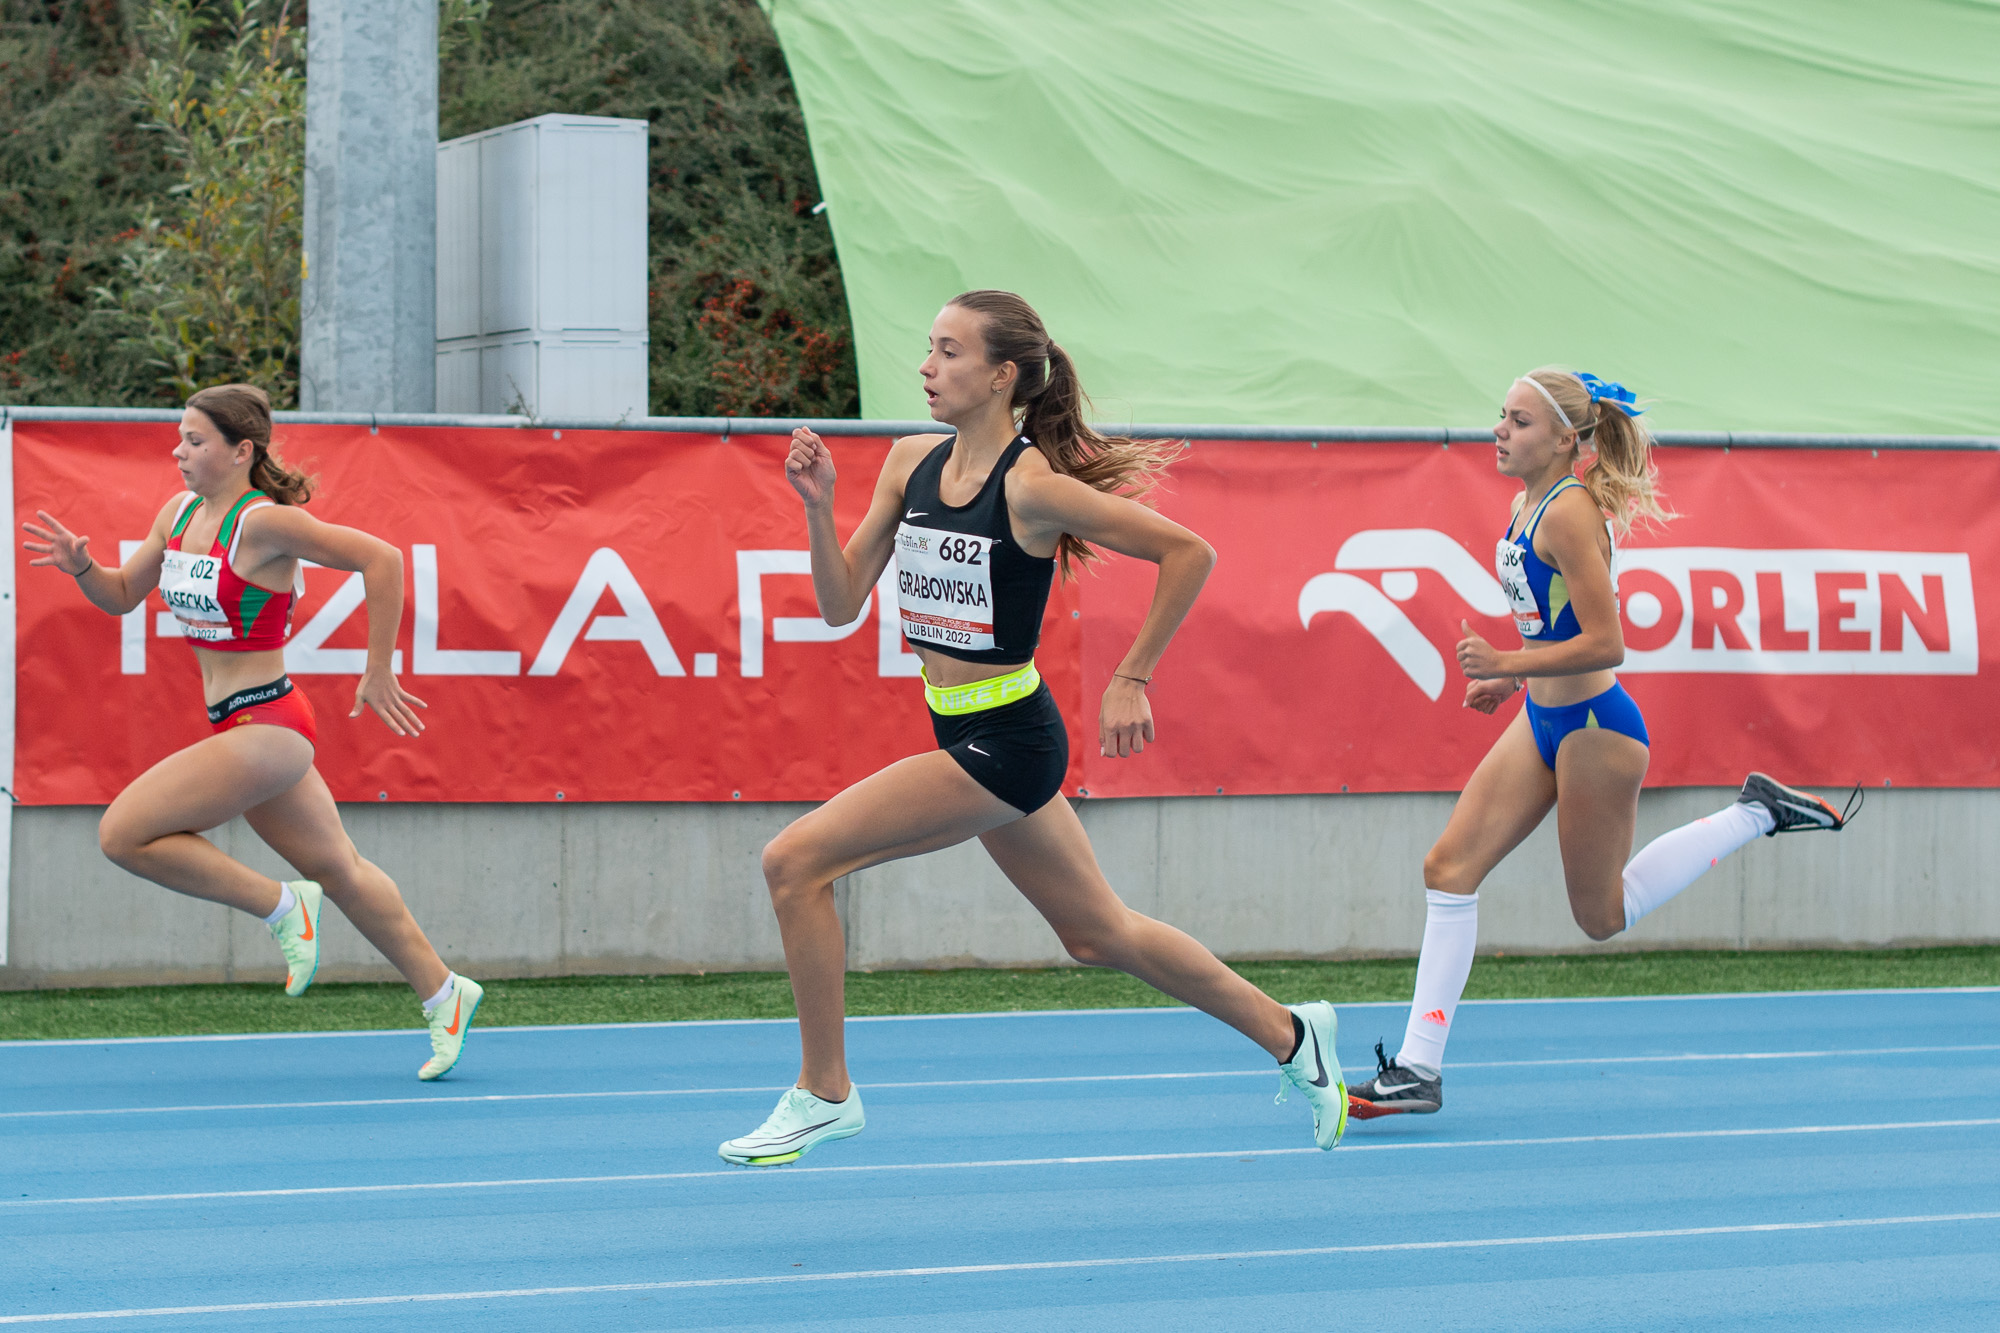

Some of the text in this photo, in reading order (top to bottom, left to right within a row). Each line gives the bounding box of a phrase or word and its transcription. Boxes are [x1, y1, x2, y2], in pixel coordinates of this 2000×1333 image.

[938, 536, 982, 566] 682
[898, 568, 989, 609] GRABOWSKA
[1617, 567, 1951, 653] ORLEN
[197, 628, 217, 640] 2022
[908, 621, 943, 640] LUBLIN
[945, 629, 972, 645] 2022
[941, 684, 994, 710] NIKE
